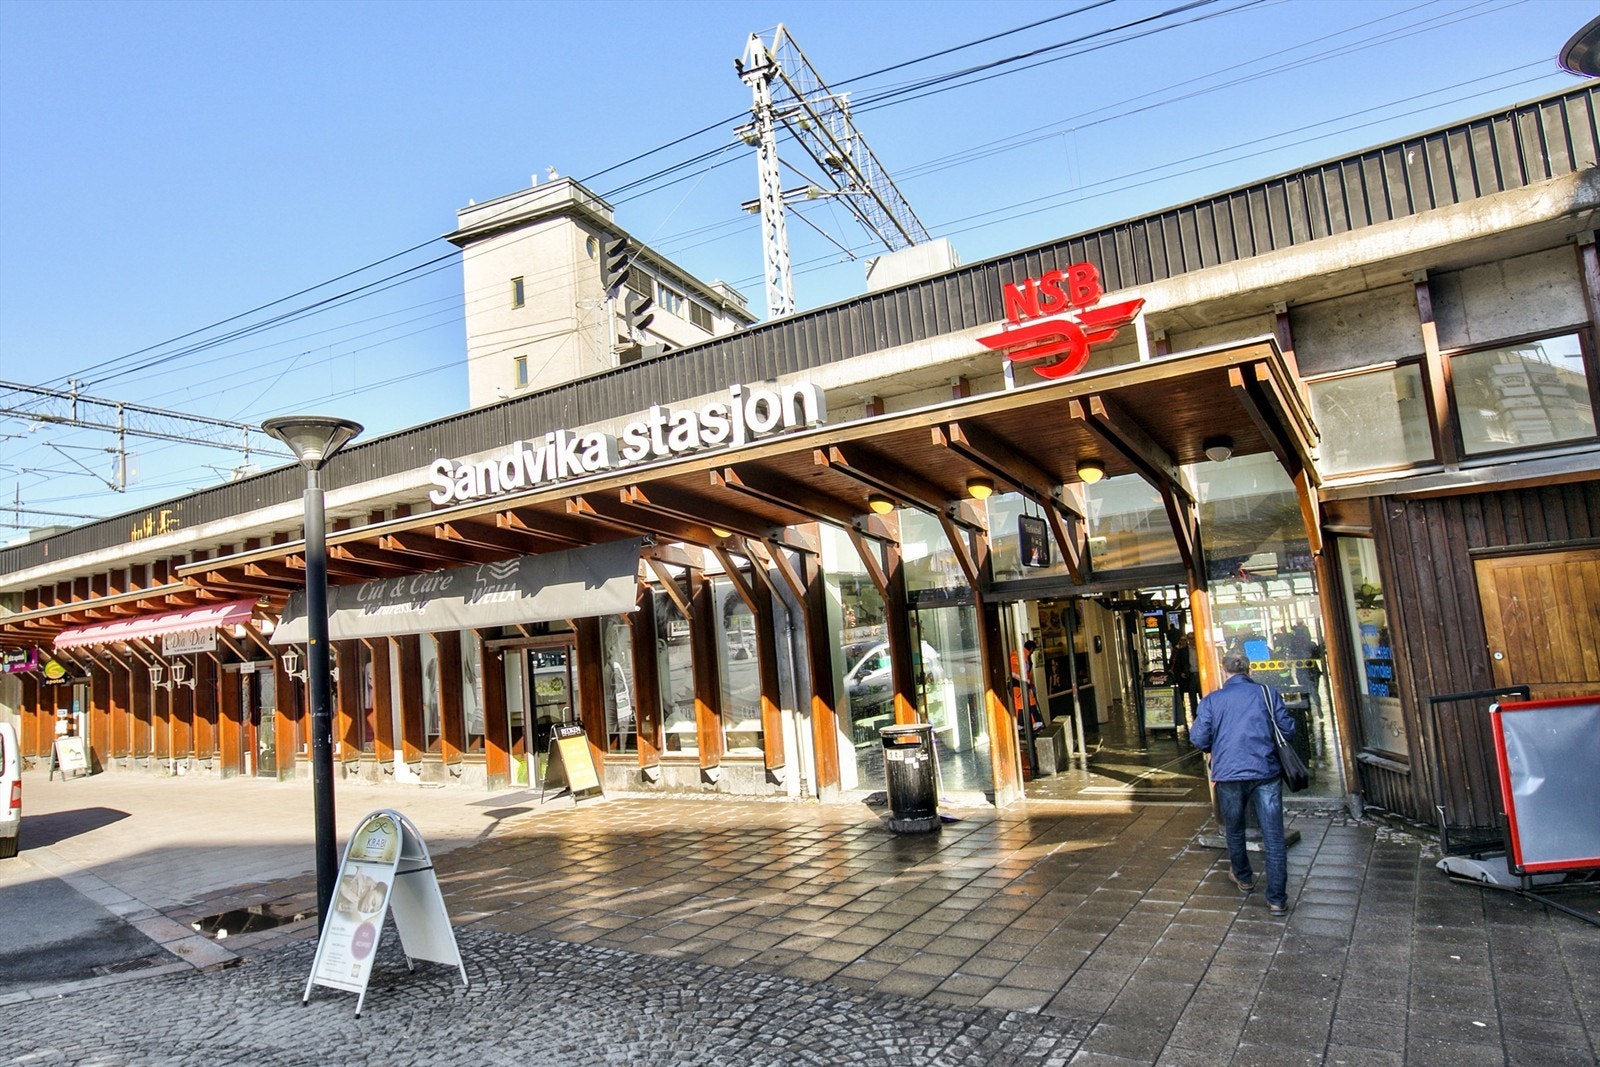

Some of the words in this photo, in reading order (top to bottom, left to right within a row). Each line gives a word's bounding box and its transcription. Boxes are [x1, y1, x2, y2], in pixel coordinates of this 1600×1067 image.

[1003, 262, 1102, 327] NSB
[429, 429, 614, 505] Sandvika
[620, 381, 823, 463] stasjon
[357, 579, 387, 602] Cut
[390, 576, 405, 598] &
[409, 572, 454, 595] Care
[465, 583, 517, 607] WELLA
